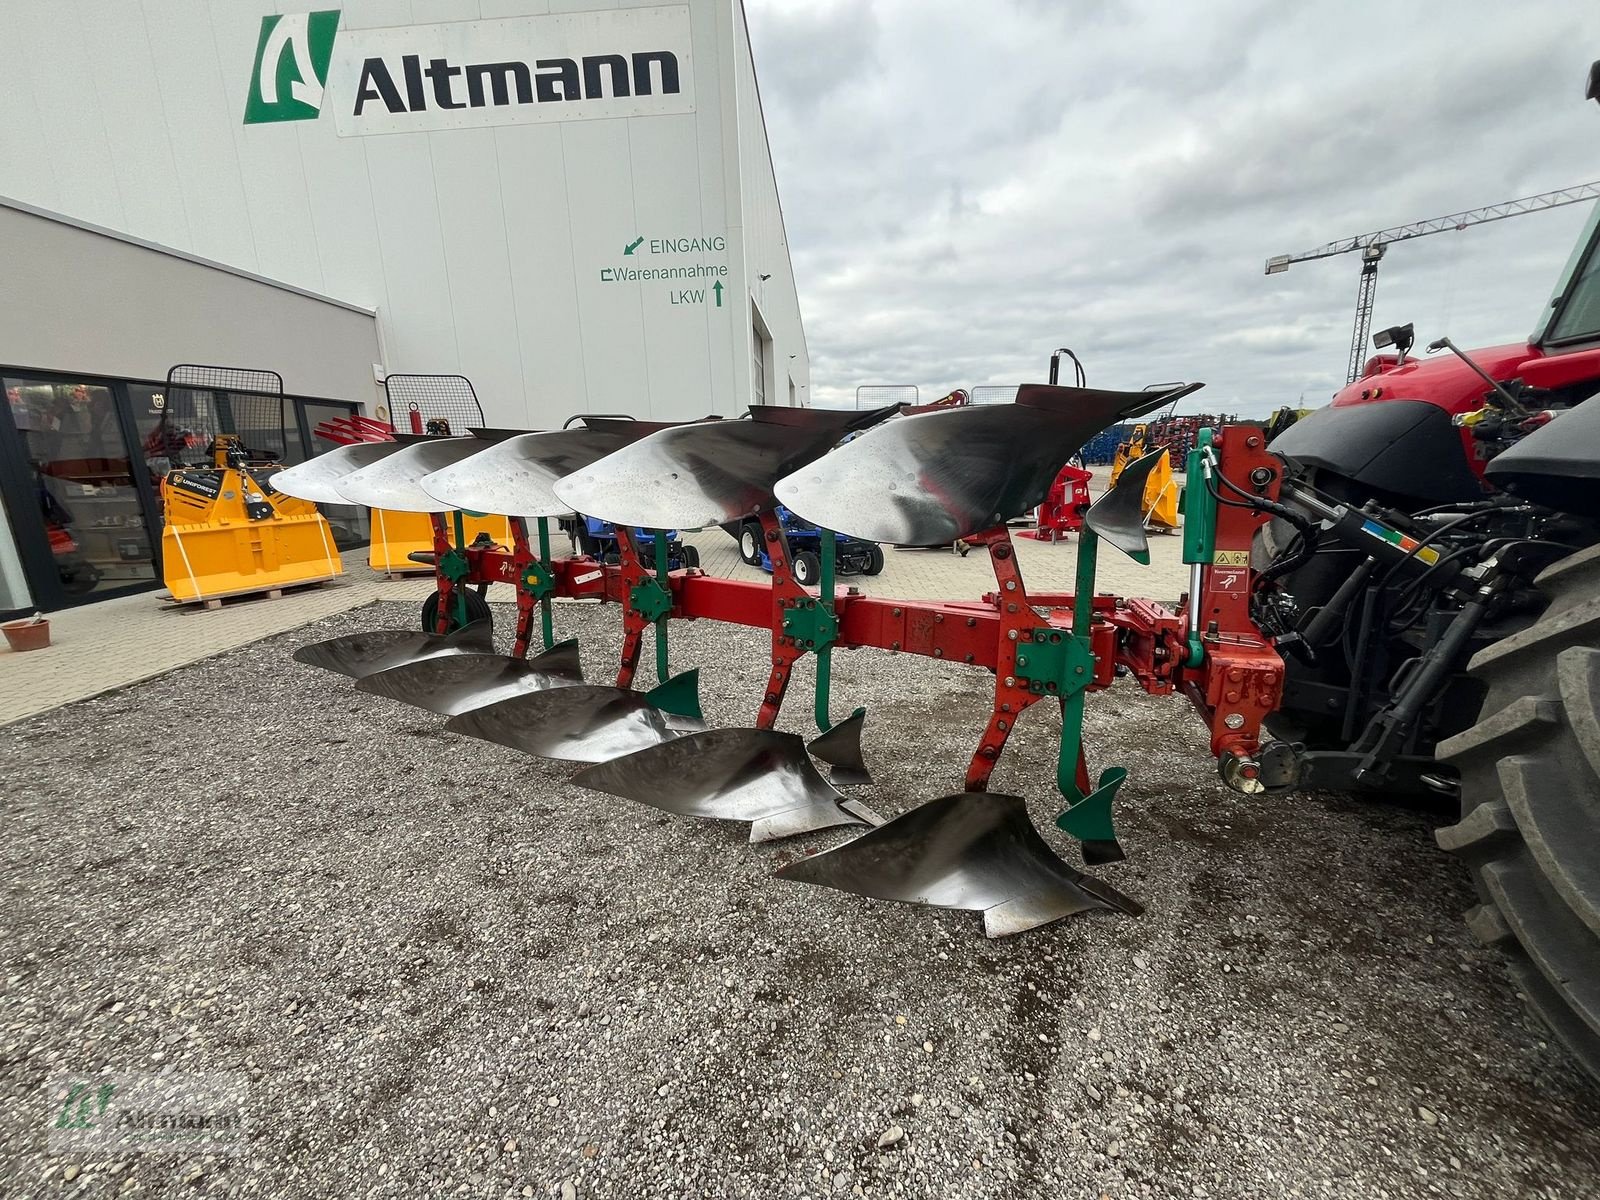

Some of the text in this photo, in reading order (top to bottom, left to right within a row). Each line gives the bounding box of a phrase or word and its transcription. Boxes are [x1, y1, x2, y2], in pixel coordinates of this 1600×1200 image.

[353, 50, 681, 116] Altmann
[650, 236, 726, 254] EINGANG
[613, 263, 728, 281] Warenannahme
[670, 289, 705, 305] LKW
[182, 478, 217, 495] UNIFOREST
